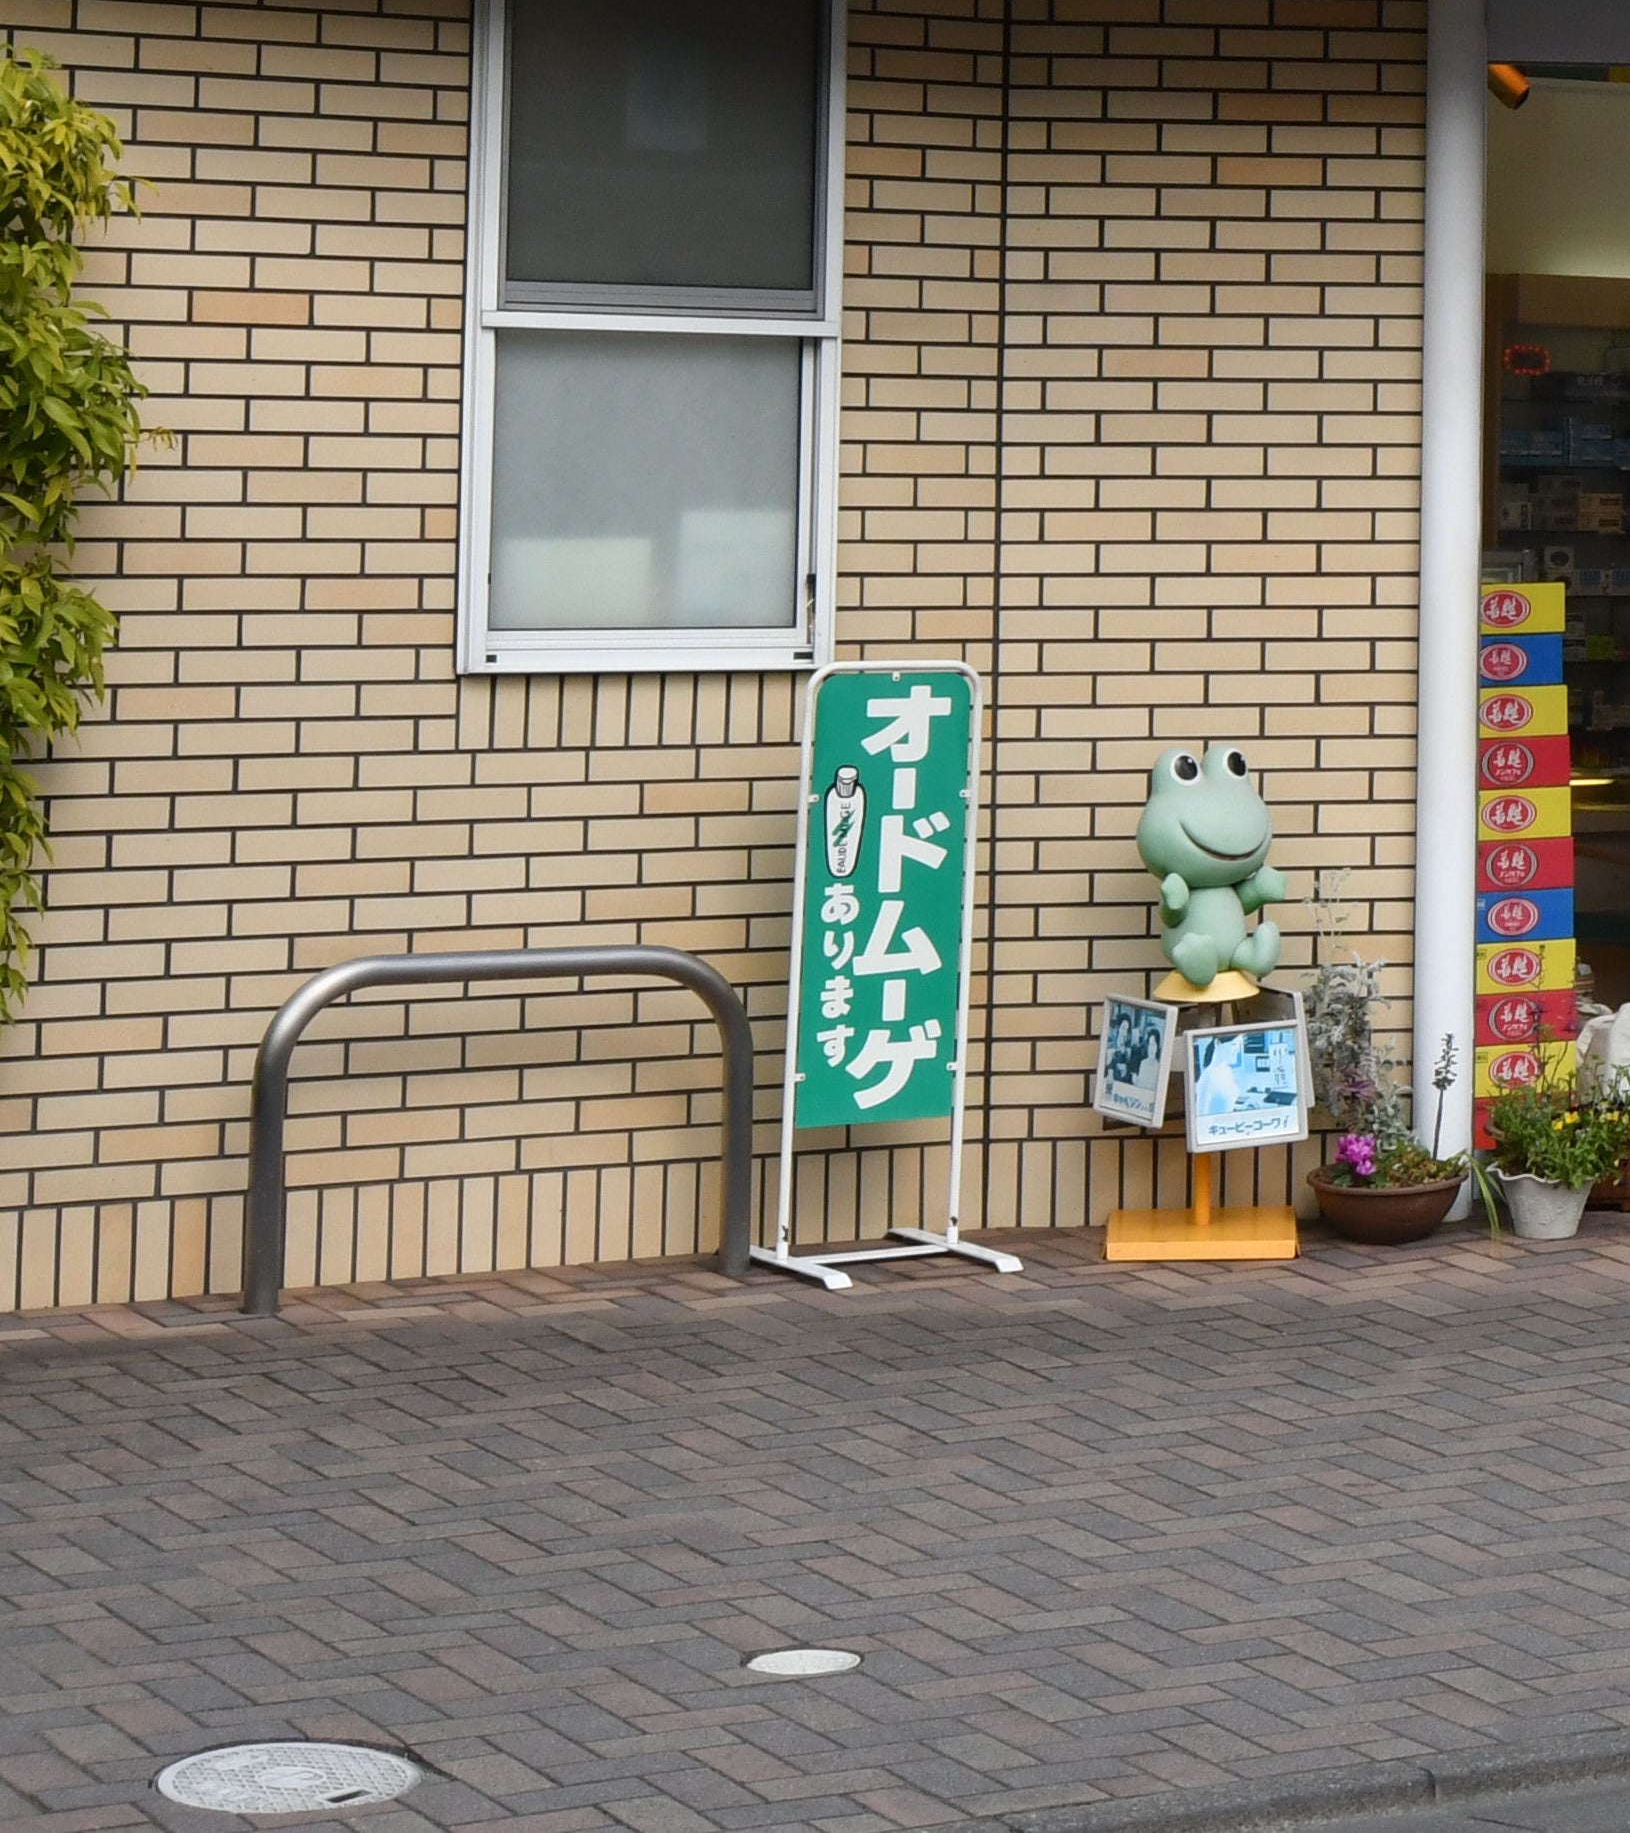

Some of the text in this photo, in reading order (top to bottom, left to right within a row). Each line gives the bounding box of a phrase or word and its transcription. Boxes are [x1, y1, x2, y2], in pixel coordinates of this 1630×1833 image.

[816, 882, 860, 1067] あります
[845, 685, 952, 1110] オードムーゲ
